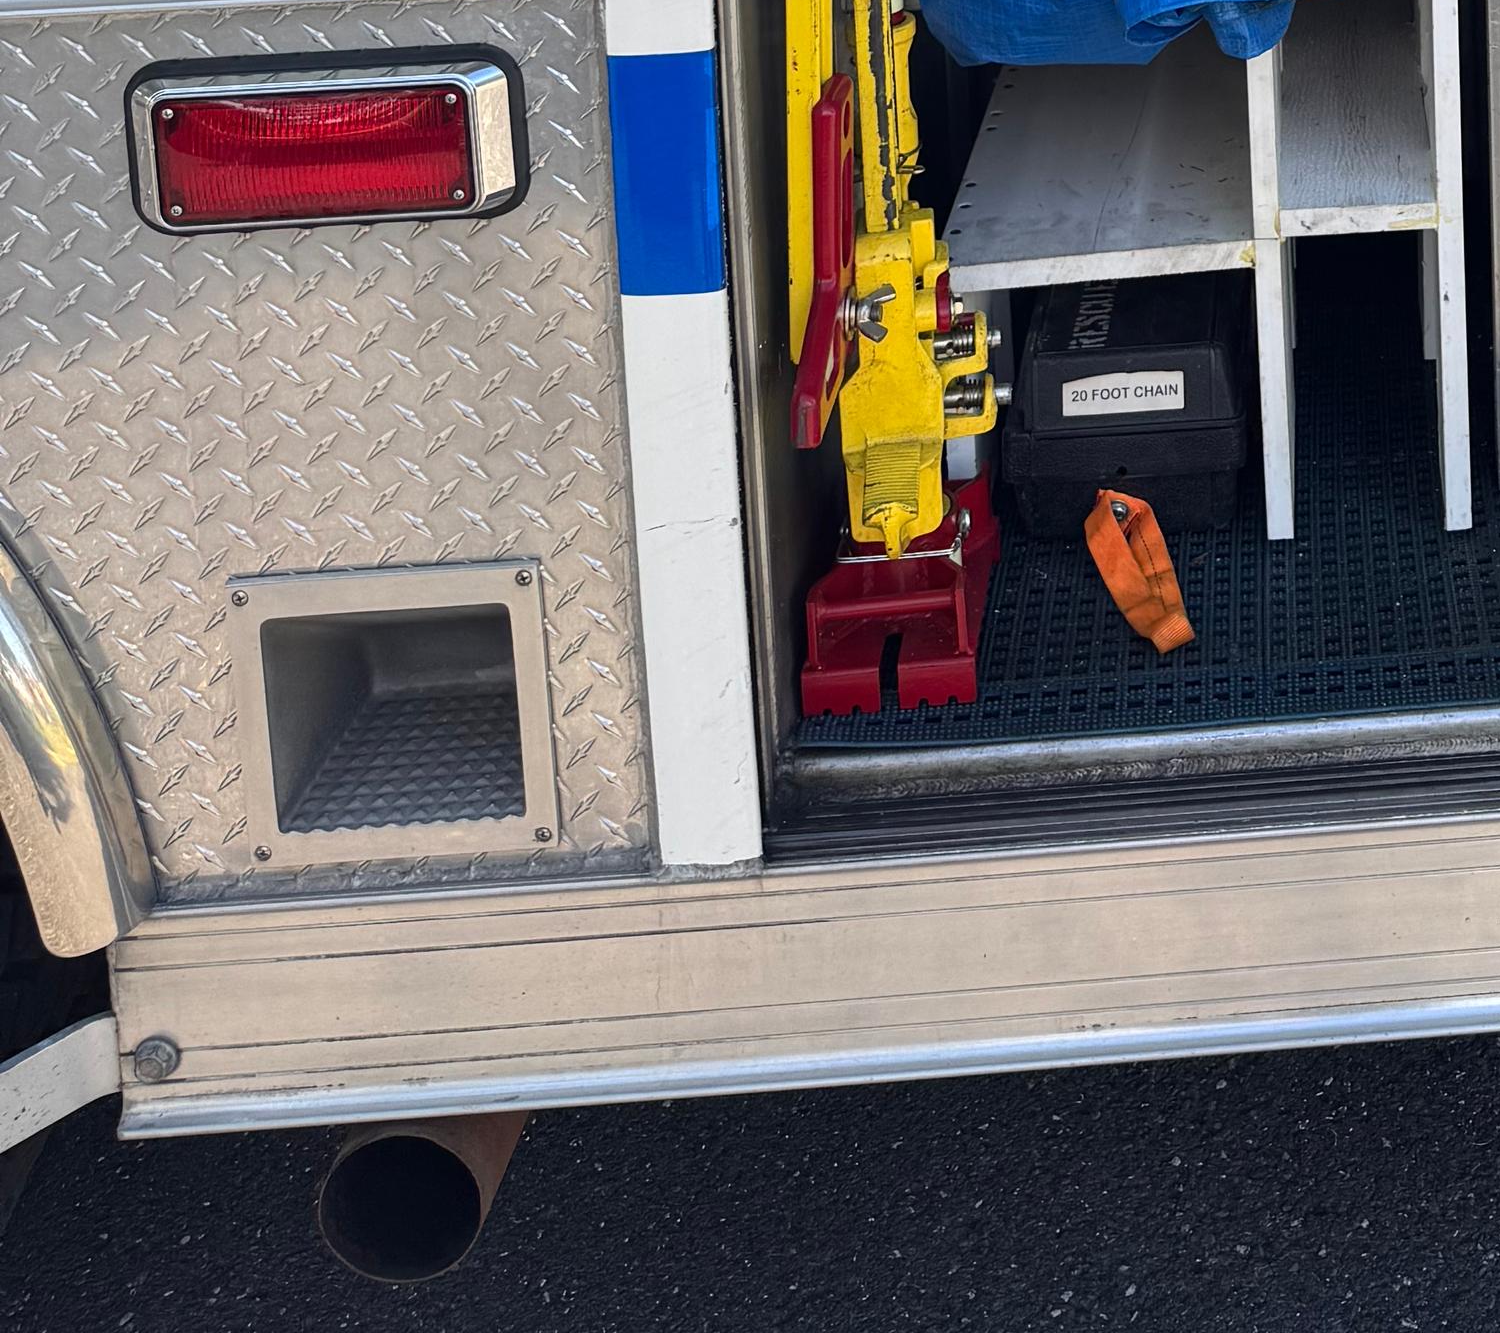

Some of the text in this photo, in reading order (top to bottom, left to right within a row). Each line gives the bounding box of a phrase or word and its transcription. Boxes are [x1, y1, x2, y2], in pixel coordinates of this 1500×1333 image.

[1071, 383, 1179, 402] 20 FOOT CHAIN
